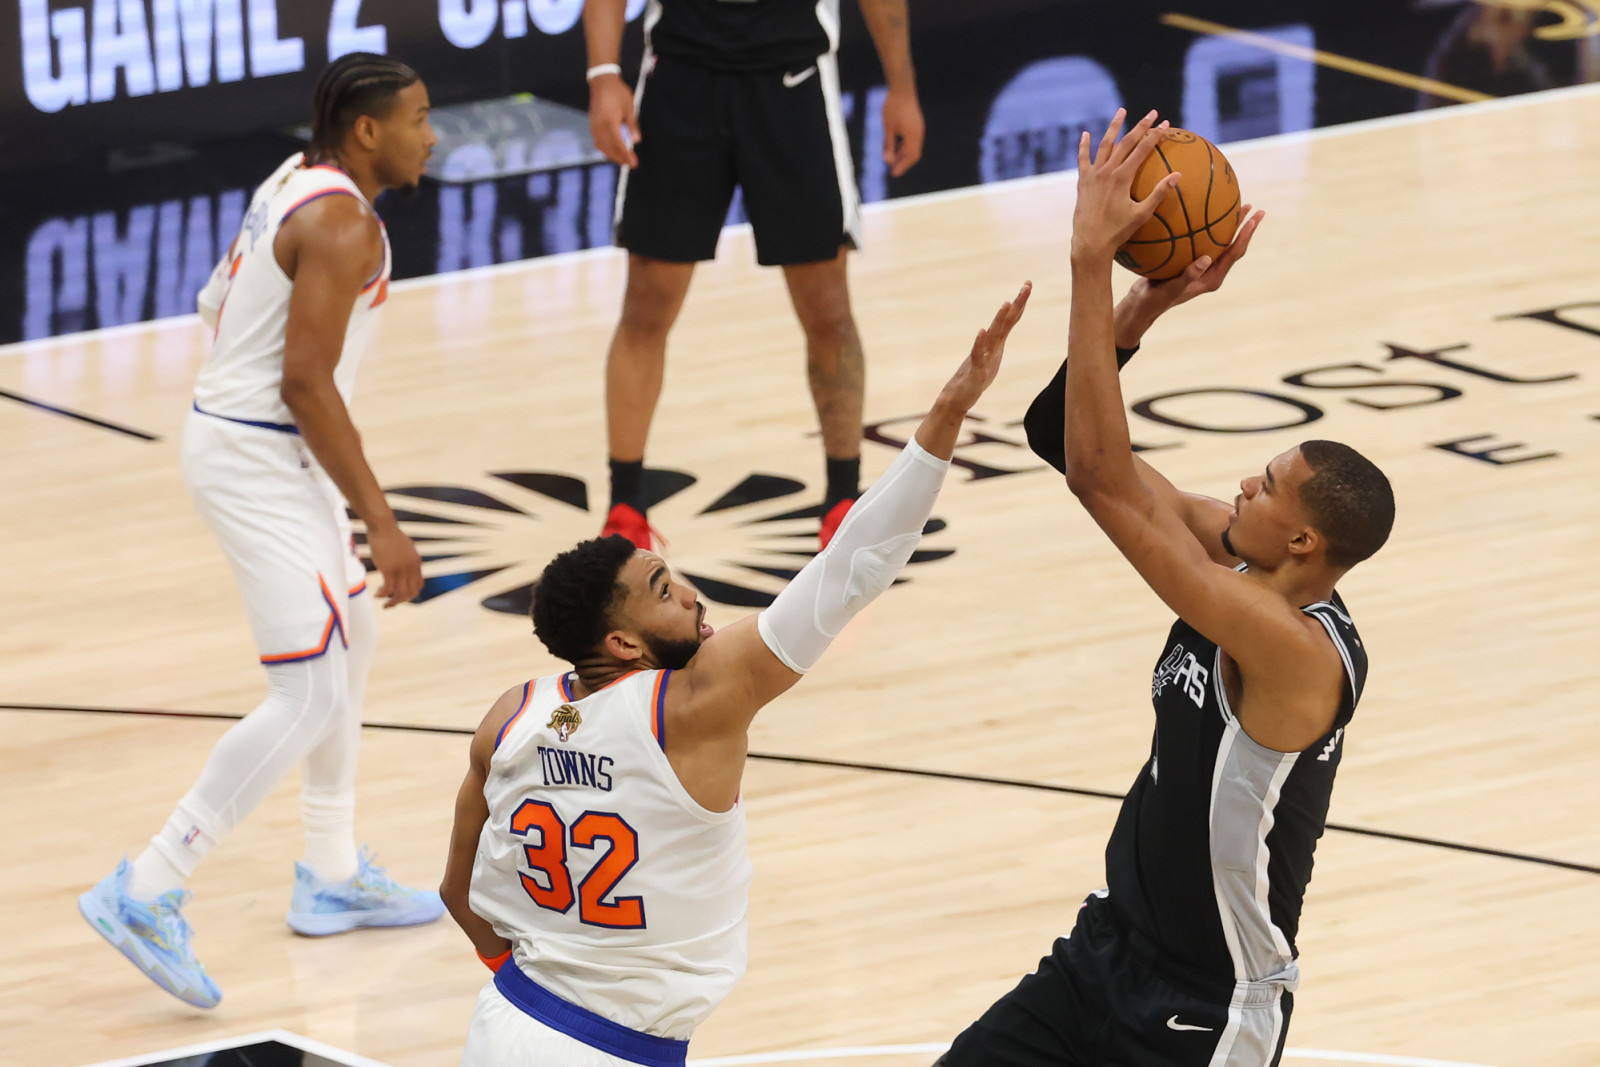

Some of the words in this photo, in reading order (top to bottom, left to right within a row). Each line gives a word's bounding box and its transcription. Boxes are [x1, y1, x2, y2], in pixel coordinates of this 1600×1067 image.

[547, 711, 580, 728] Finals
[537, 746, 614, 792] TOWNS
[510, 798, 647, 930] 32
